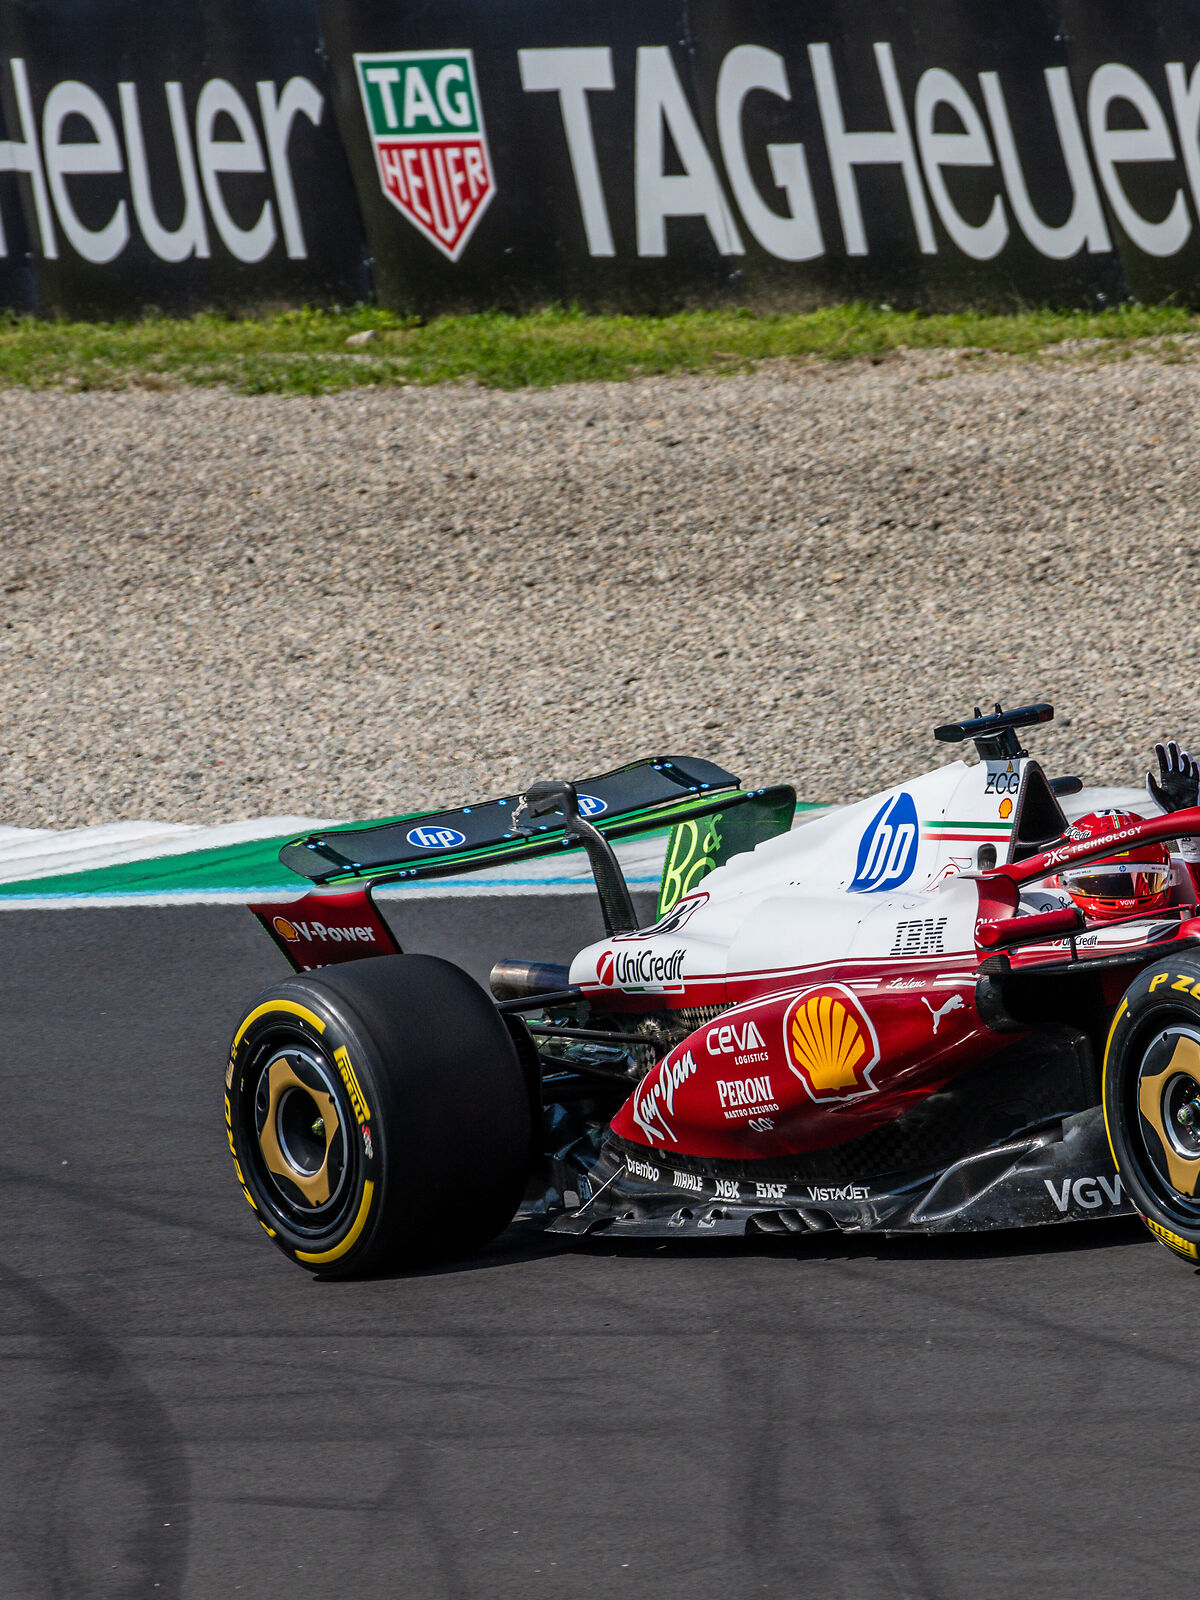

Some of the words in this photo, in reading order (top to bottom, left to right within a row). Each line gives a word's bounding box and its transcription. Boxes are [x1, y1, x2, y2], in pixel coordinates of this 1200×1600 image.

[366, 63, 472, 130] TAG
[379, 146, 487, 252] HEUER
[984, 772, 1020, 795] ZCG
[416, 828, 454, 848] hp
[857, 792, 916, 893] hp
[1042, 845, 1070, 868] DXC
[1071, 826, 1142, 854] TECHNOLOGY
[292, 921, 376, 942] V-Power
[889, 917, 948, 956] IBM
[615, 949, 687, 983] UniCredit
[885, 976, 927, 989] Leclerc
[1148, 973, 1169, 993] P
[734, 1051, 769, 1066] LOGISTICS
[333, 1044, 371, 1125] PIRELLI
[716, 1075, 775, 1108] PERONI
[723, 1109, 748, 1120] NASTRO
[748, 1103, 780, 1116] AZZURRO
[625, 1154, 660, 1182] brembo
[672, 1170, 703, 1192] MAHLE
[714, 1179, 740, 1199] NGK
[755, 1182, 788, 1199] SKF
